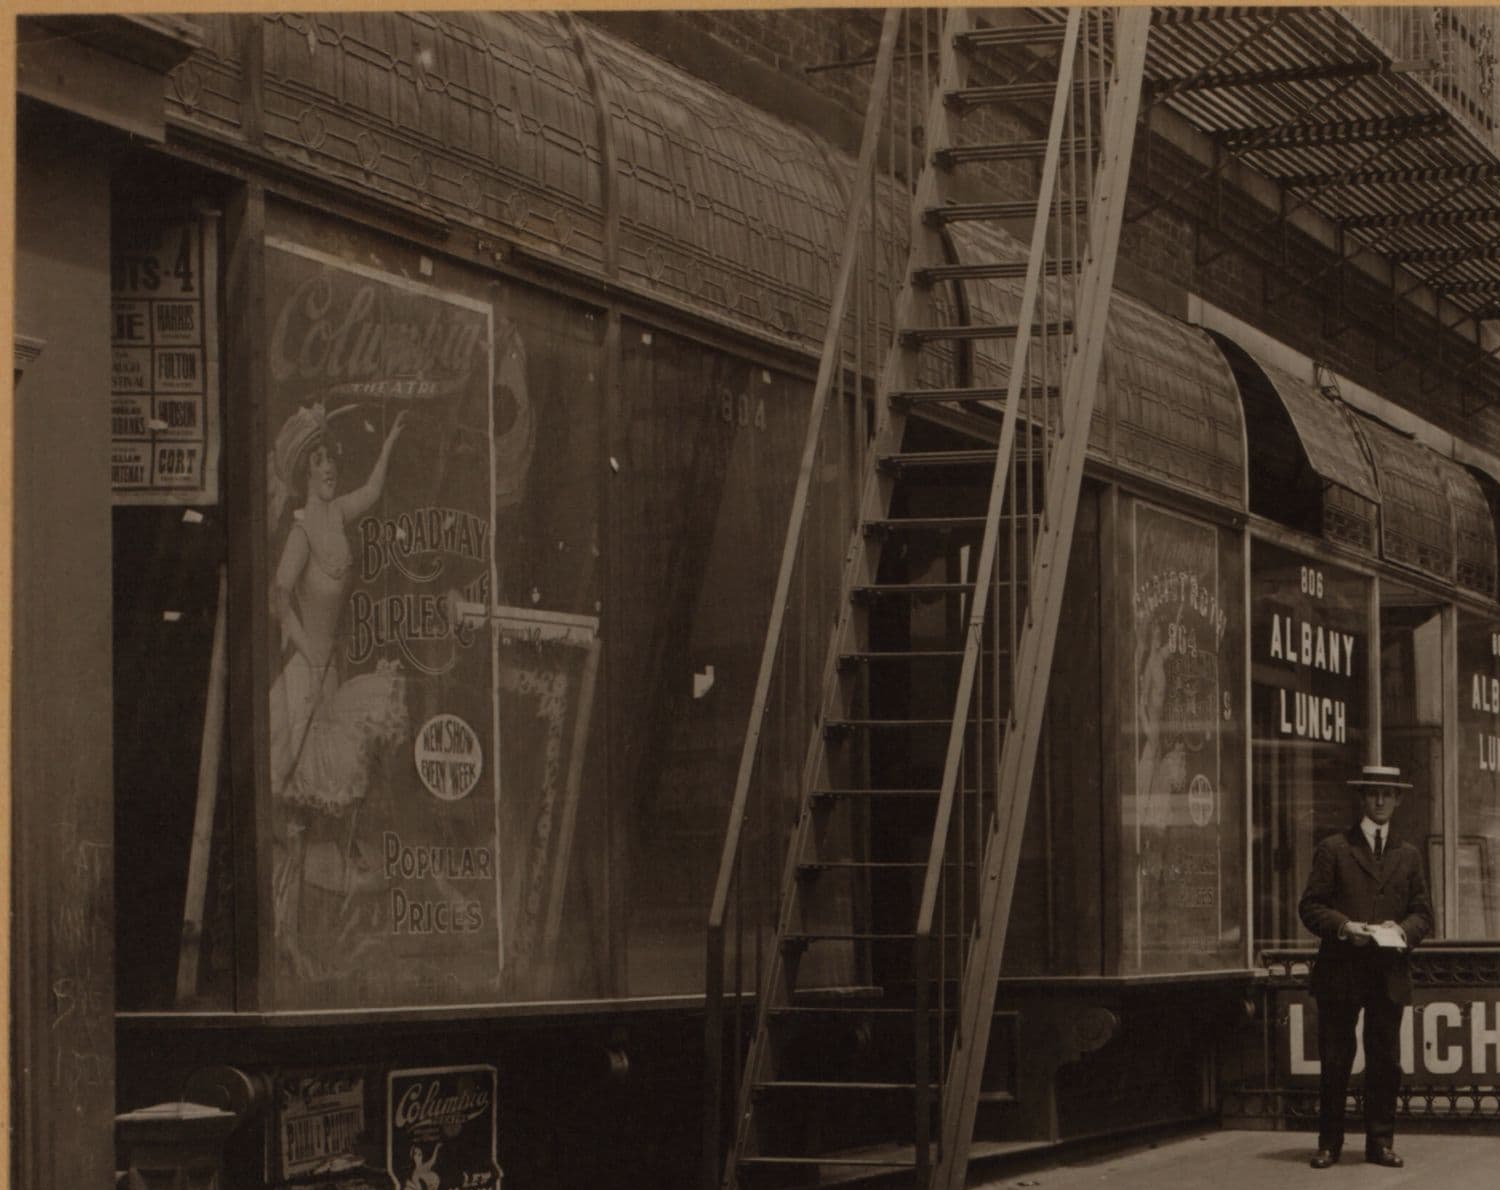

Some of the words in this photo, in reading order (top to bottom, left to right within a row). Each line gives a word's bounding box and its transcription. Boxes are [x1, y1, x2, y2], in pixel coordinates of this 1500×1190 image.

[157, 303, 195, 332] HARRIS
[158, 352, 196, 380] FULTON
[158, 448, 196, 475] CORT
[360, 506, 490, 584] BROADWAY
[1301, 565, 1324, 599] 806
[1270, 613, 1355, 678] ALBANY
[1280, 687, 1346, 744] LUNCH
[424, 720, 443, 752] NEW
[444, 719, 474, 755] SHOW
[421, 759, 446, 794] EVERY
[449, 761, 477, 797] WEEK
[383, 831, 497, 880] POPULAR
[391, 887, 483, 935] PRICES
[395, 1079, 490, 1129] Columbia
[461, 1170, 493, 1189] LEW
